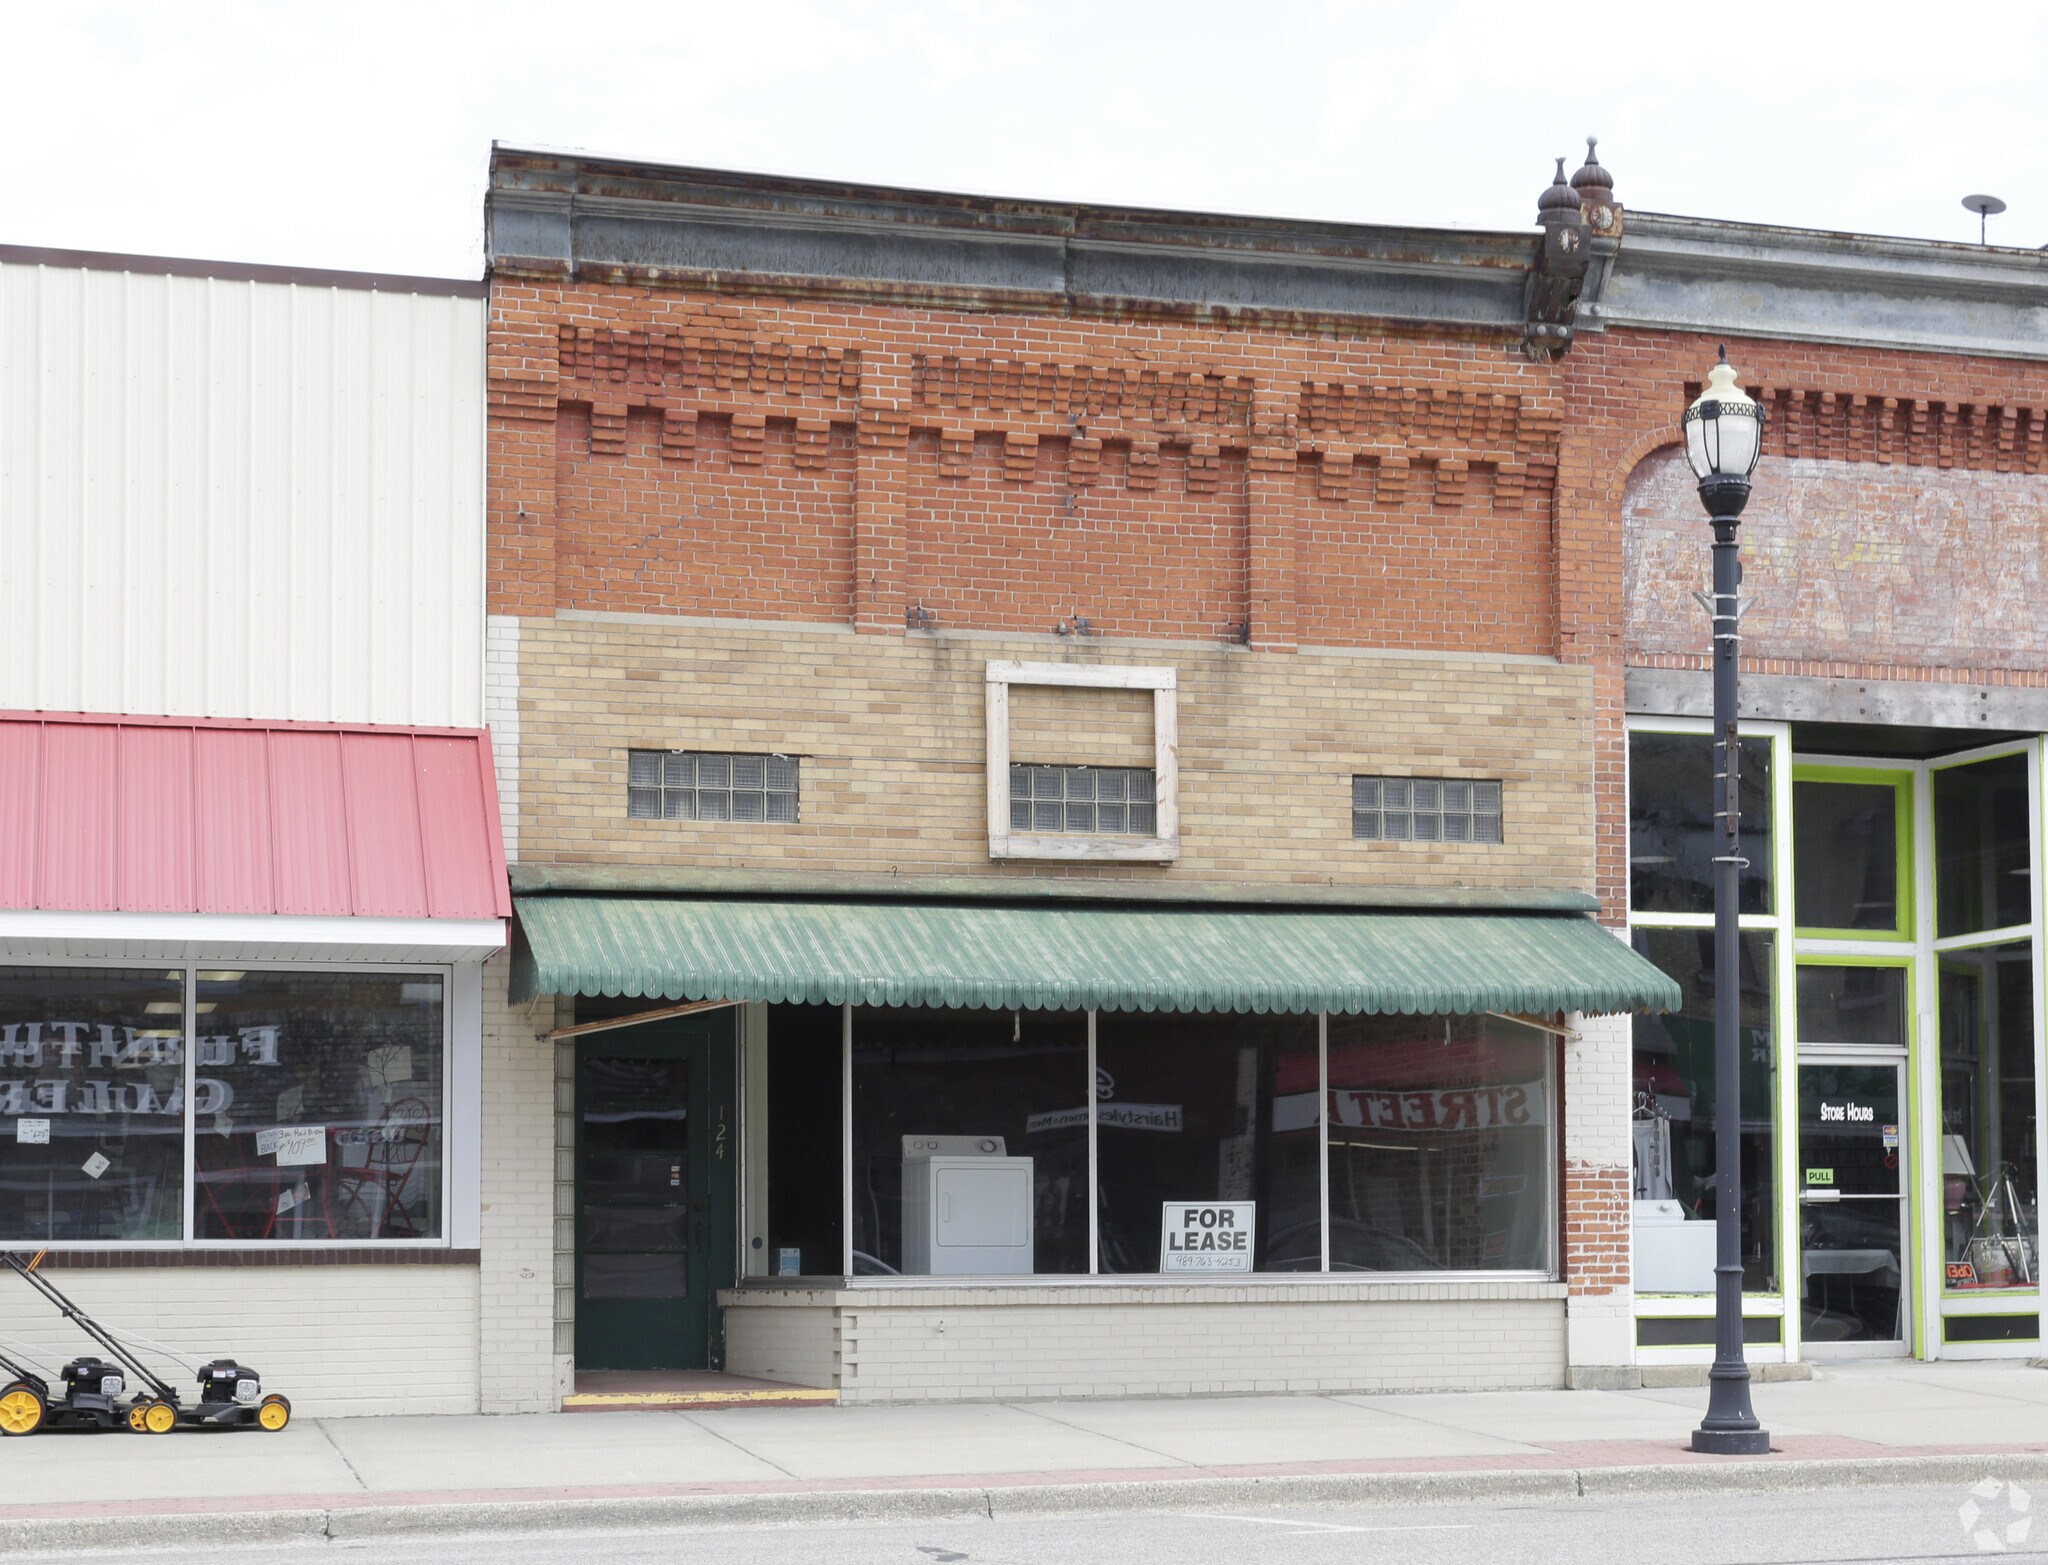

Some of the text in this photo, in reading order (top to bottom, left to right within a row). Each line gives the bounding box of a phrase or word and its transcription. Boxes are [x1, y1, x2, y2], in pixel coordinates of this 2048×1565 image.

[1808, 1171, 1831, 1181] PULL
[1183, 1208, 1235, 1229] FOR
[1168, 1231, 1248, 1251] LEASE
